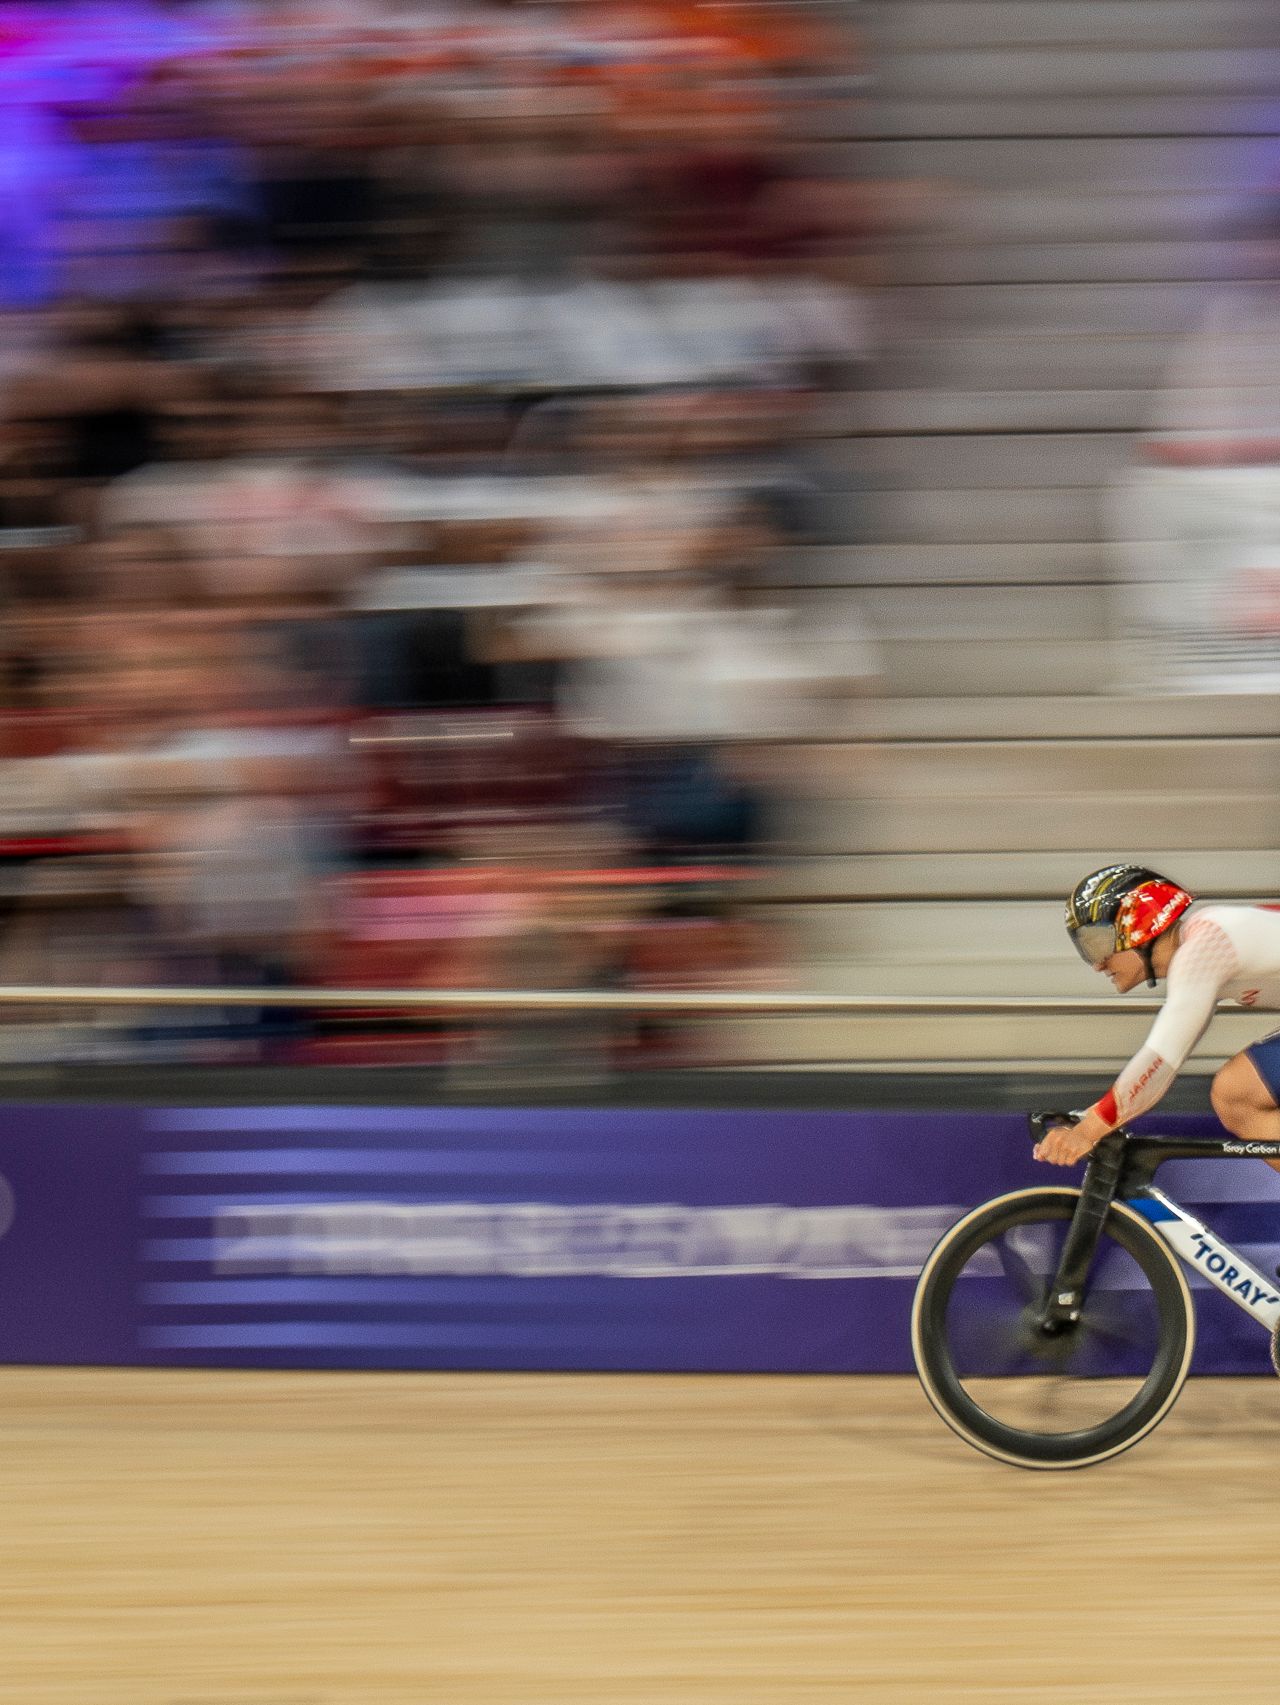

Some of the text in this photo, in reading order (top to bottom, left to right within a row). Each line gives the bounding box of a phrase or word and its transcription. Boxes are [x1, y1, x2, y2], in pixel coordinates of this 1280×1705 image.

[1128, 1056, 1164, 1104] JAPAN
[1222, 1141, 1245, 1155] Toray
[1246, 1142, 1277, 1154] Carbon
